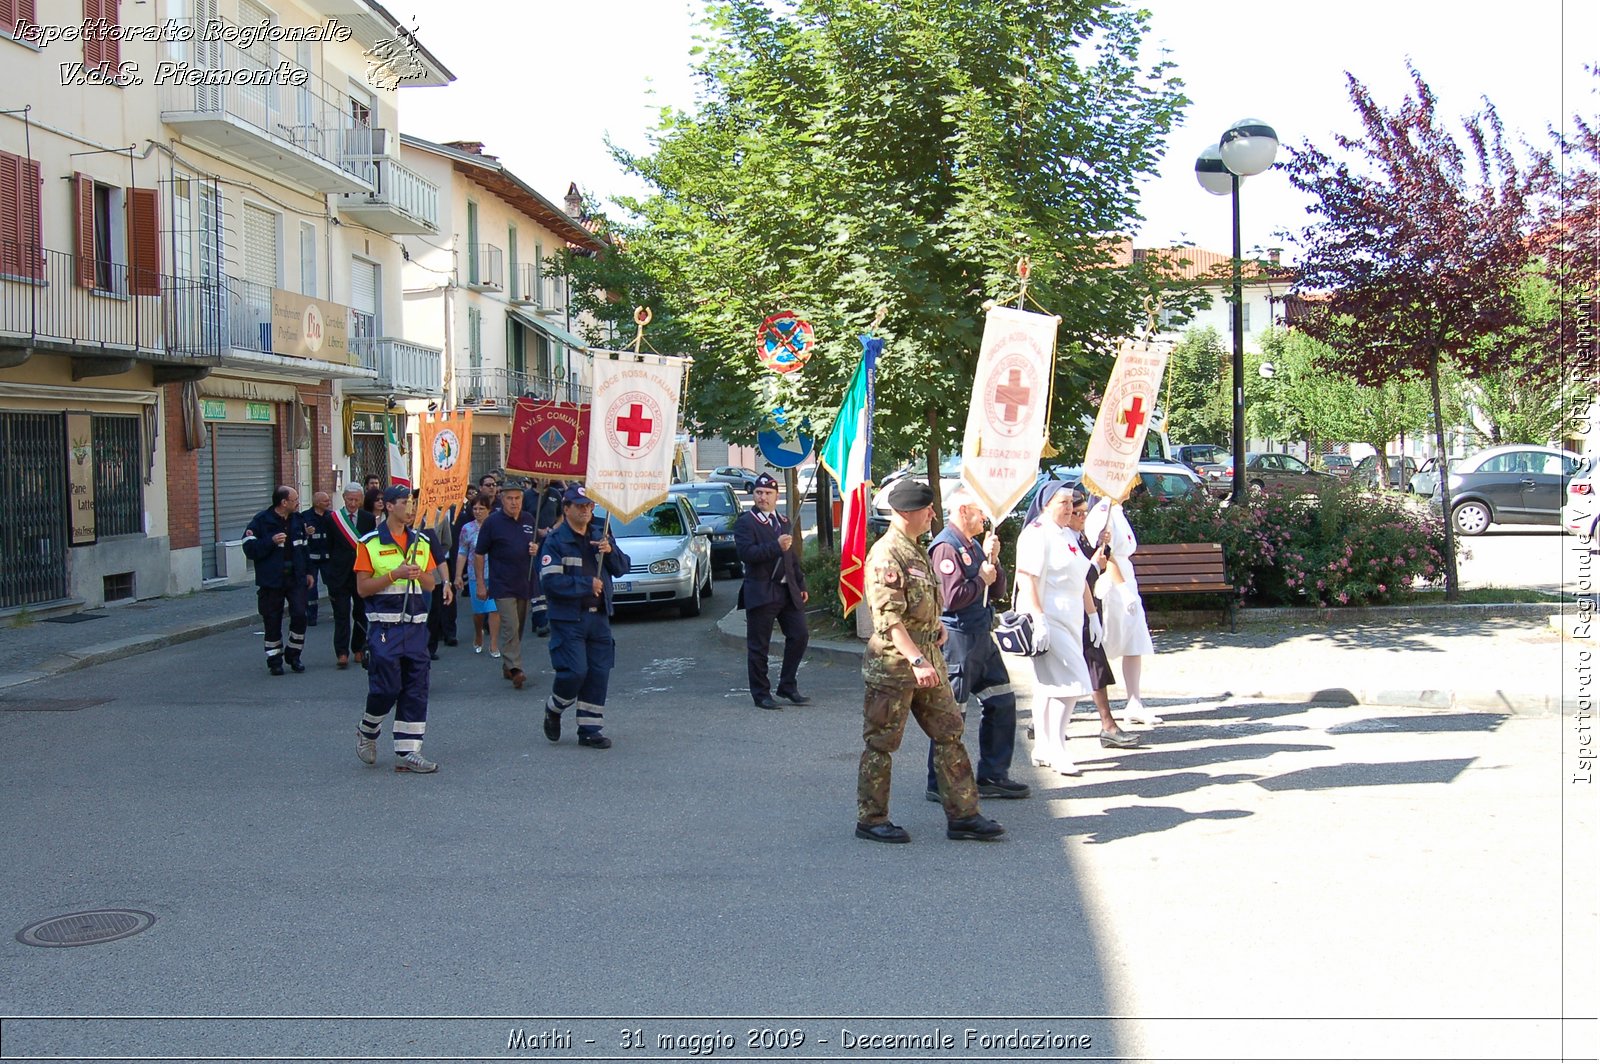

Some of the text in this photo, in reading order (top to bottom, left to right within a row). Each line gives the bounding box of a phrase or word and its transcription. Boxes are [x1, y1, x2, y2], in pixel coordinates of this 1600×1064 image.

[307, 312, 321, 341] Lia
[241, 382, 258, 396] LIA
[596, 369, 678, 404] CROCE ROSSA ITALIANA
[520, 414, 544, 434] A.V.I.S.
[980, 448, 1021, 459] ELEGAZIONE
[535, 460, 562, 469] MATHI
[1093, 458, 1126, 470] COMITATO
[598, 469, 664, 478] COMITATO LOCALE
[1106, 471, 1128, 482] FIAN
[71, 483, 87, 495] Pane
[593, 482, 667, 491] SETTIMO TORINESE
[78, 499, 94, 510] Latte
